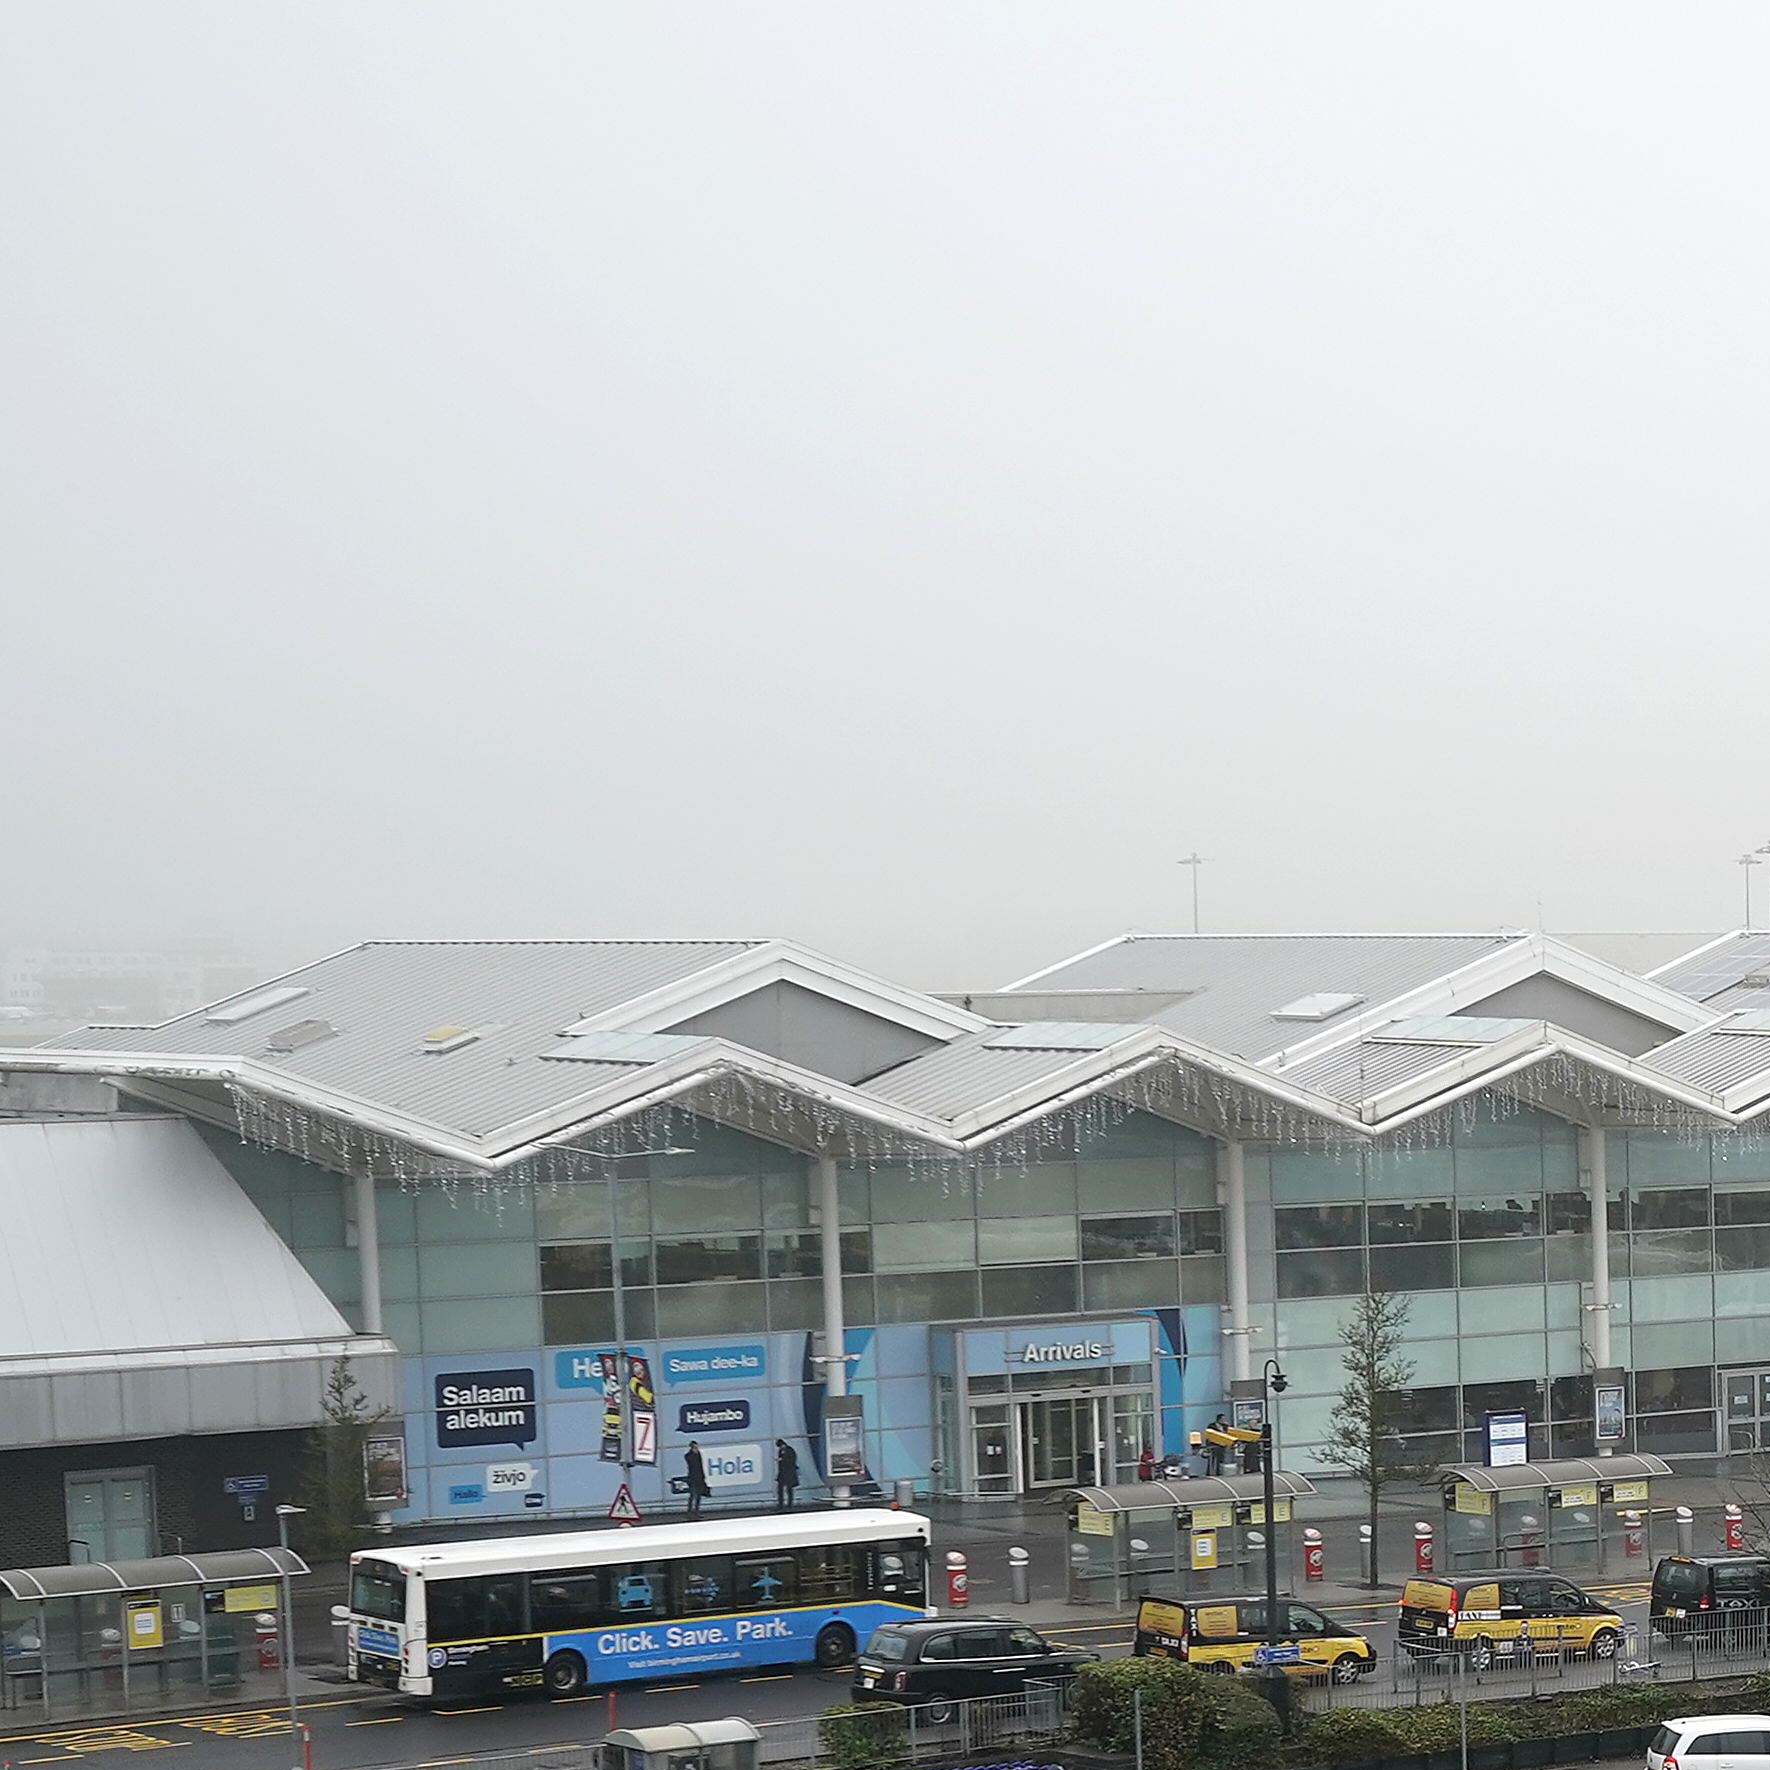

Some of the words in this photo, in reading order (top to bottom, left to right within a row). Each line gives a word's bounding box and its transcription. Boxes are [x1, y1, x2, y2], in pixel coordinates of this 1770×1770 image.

[1022, 1340, 1102, 1363] Arrivals
[669, 1357, 708, 1373] Sawa
[710, 1354, 759, 1370] dee-ka
[442, 1384, 525, 1406] Salaam
[445, 1408, 525, 1430] alekum
[686, 1406, 743, 1425] Hujambo
[492, 1467, 526, 1485] živjo
[708, 1454, 753, 1476] Hola
[597, 1631, 659, 1654] Click.
[667, 1626, 728, 1648] Save.
[736, 1618, 793, 1641] Park.
